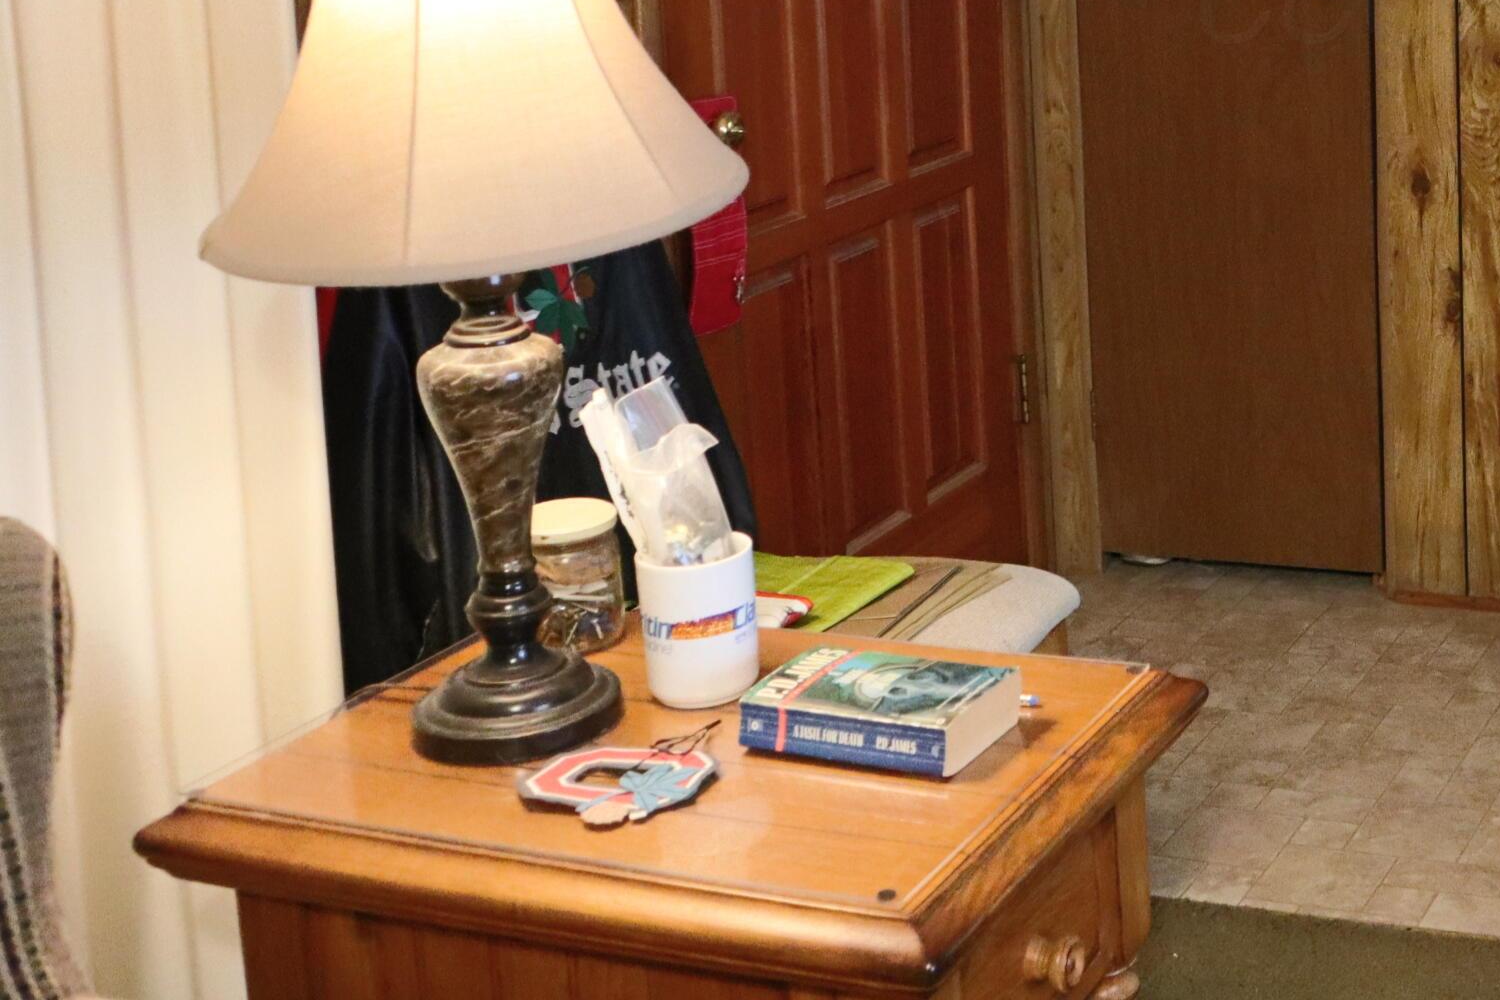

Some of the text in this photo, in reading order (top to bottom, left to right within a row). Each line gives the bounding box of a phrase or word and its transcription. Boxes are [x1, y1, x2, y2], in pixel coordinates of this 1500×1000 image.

[822, 728, 838, 744] FOR
[838, 730, 865, 747] DEATH
[890, 737, 918, 755] JAMES
